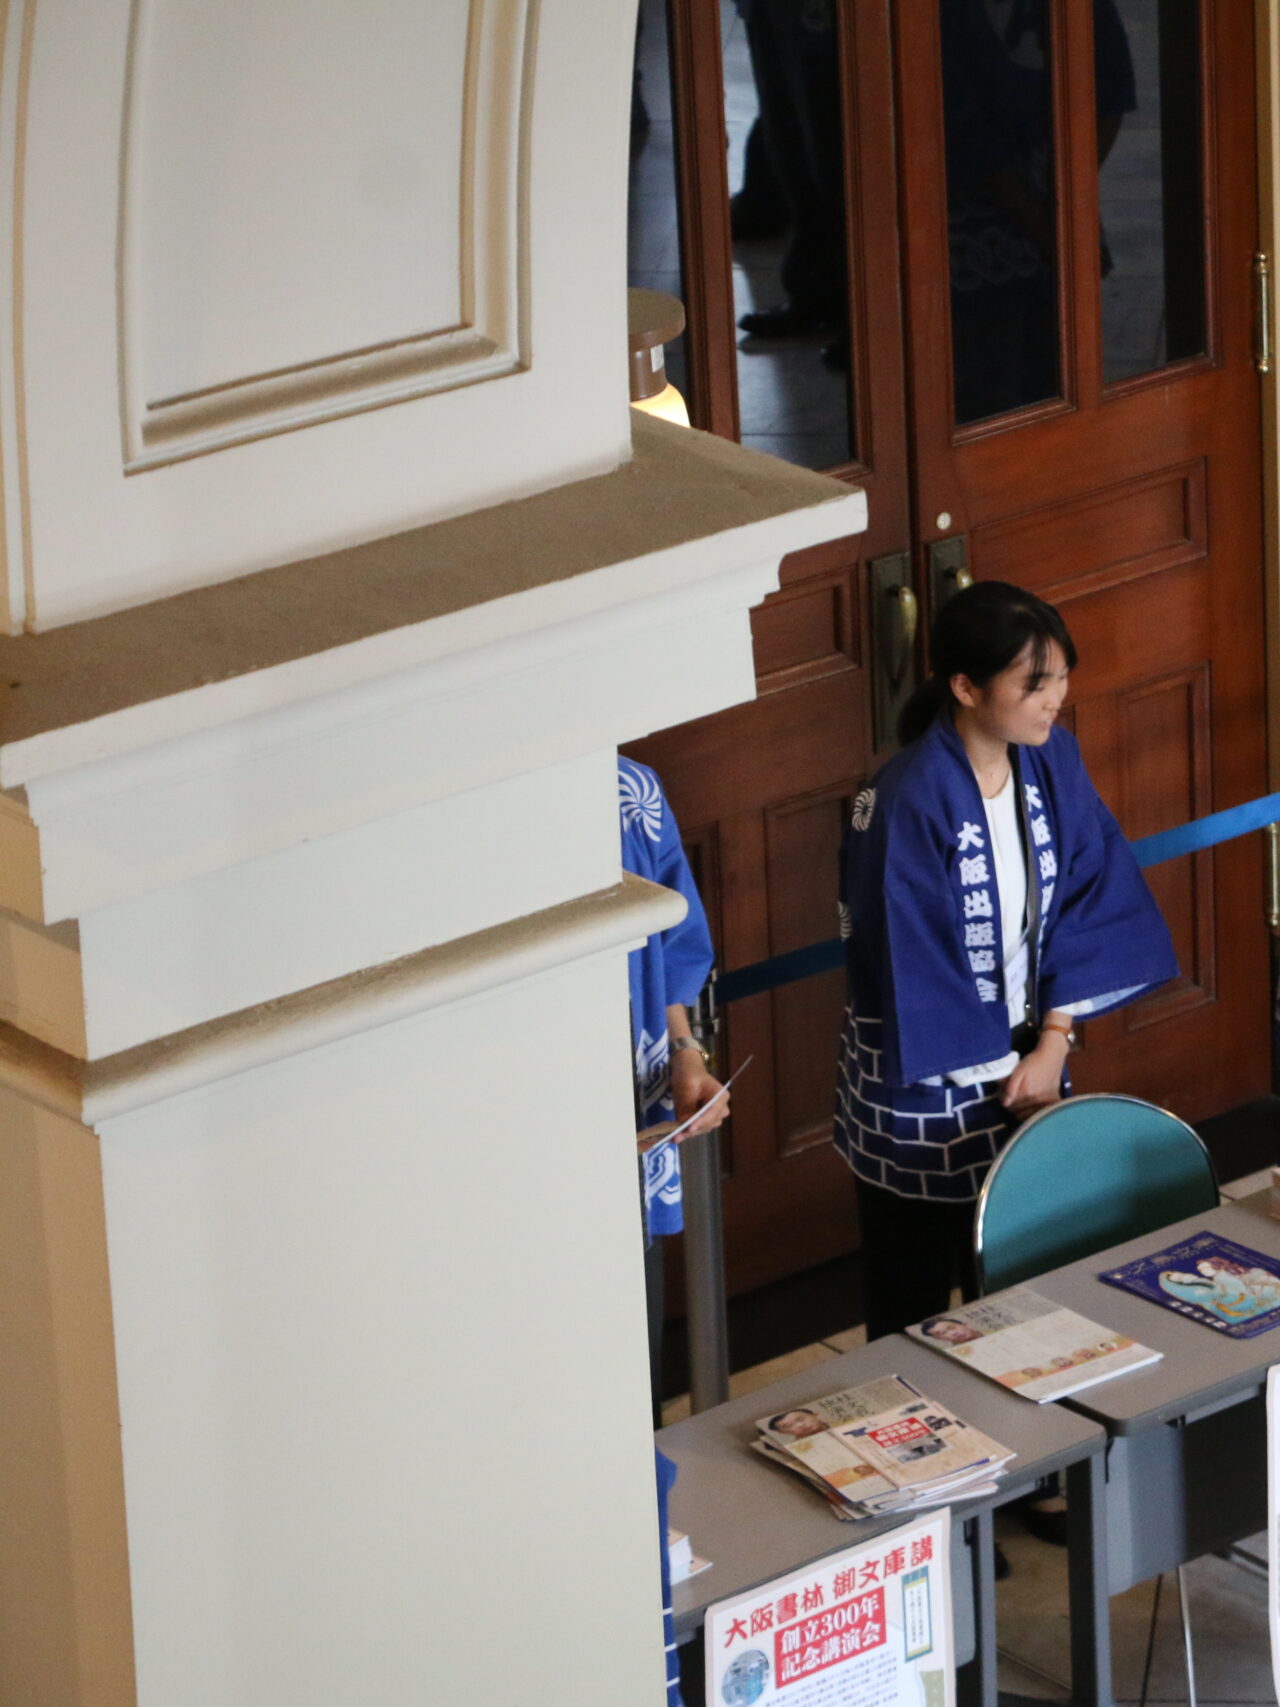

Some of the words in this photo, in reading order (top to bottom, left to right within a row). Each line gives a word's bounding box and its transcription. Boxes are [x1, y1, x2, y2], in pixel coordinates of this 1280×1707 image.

[724, 1583, 824, 1649] 大阪書林
[832, 1535, 933, 1600] 御文庫講
[780, 1593, 881, 1655] 創立300年
[780, 1621, 881, 1681] 記念講演会
